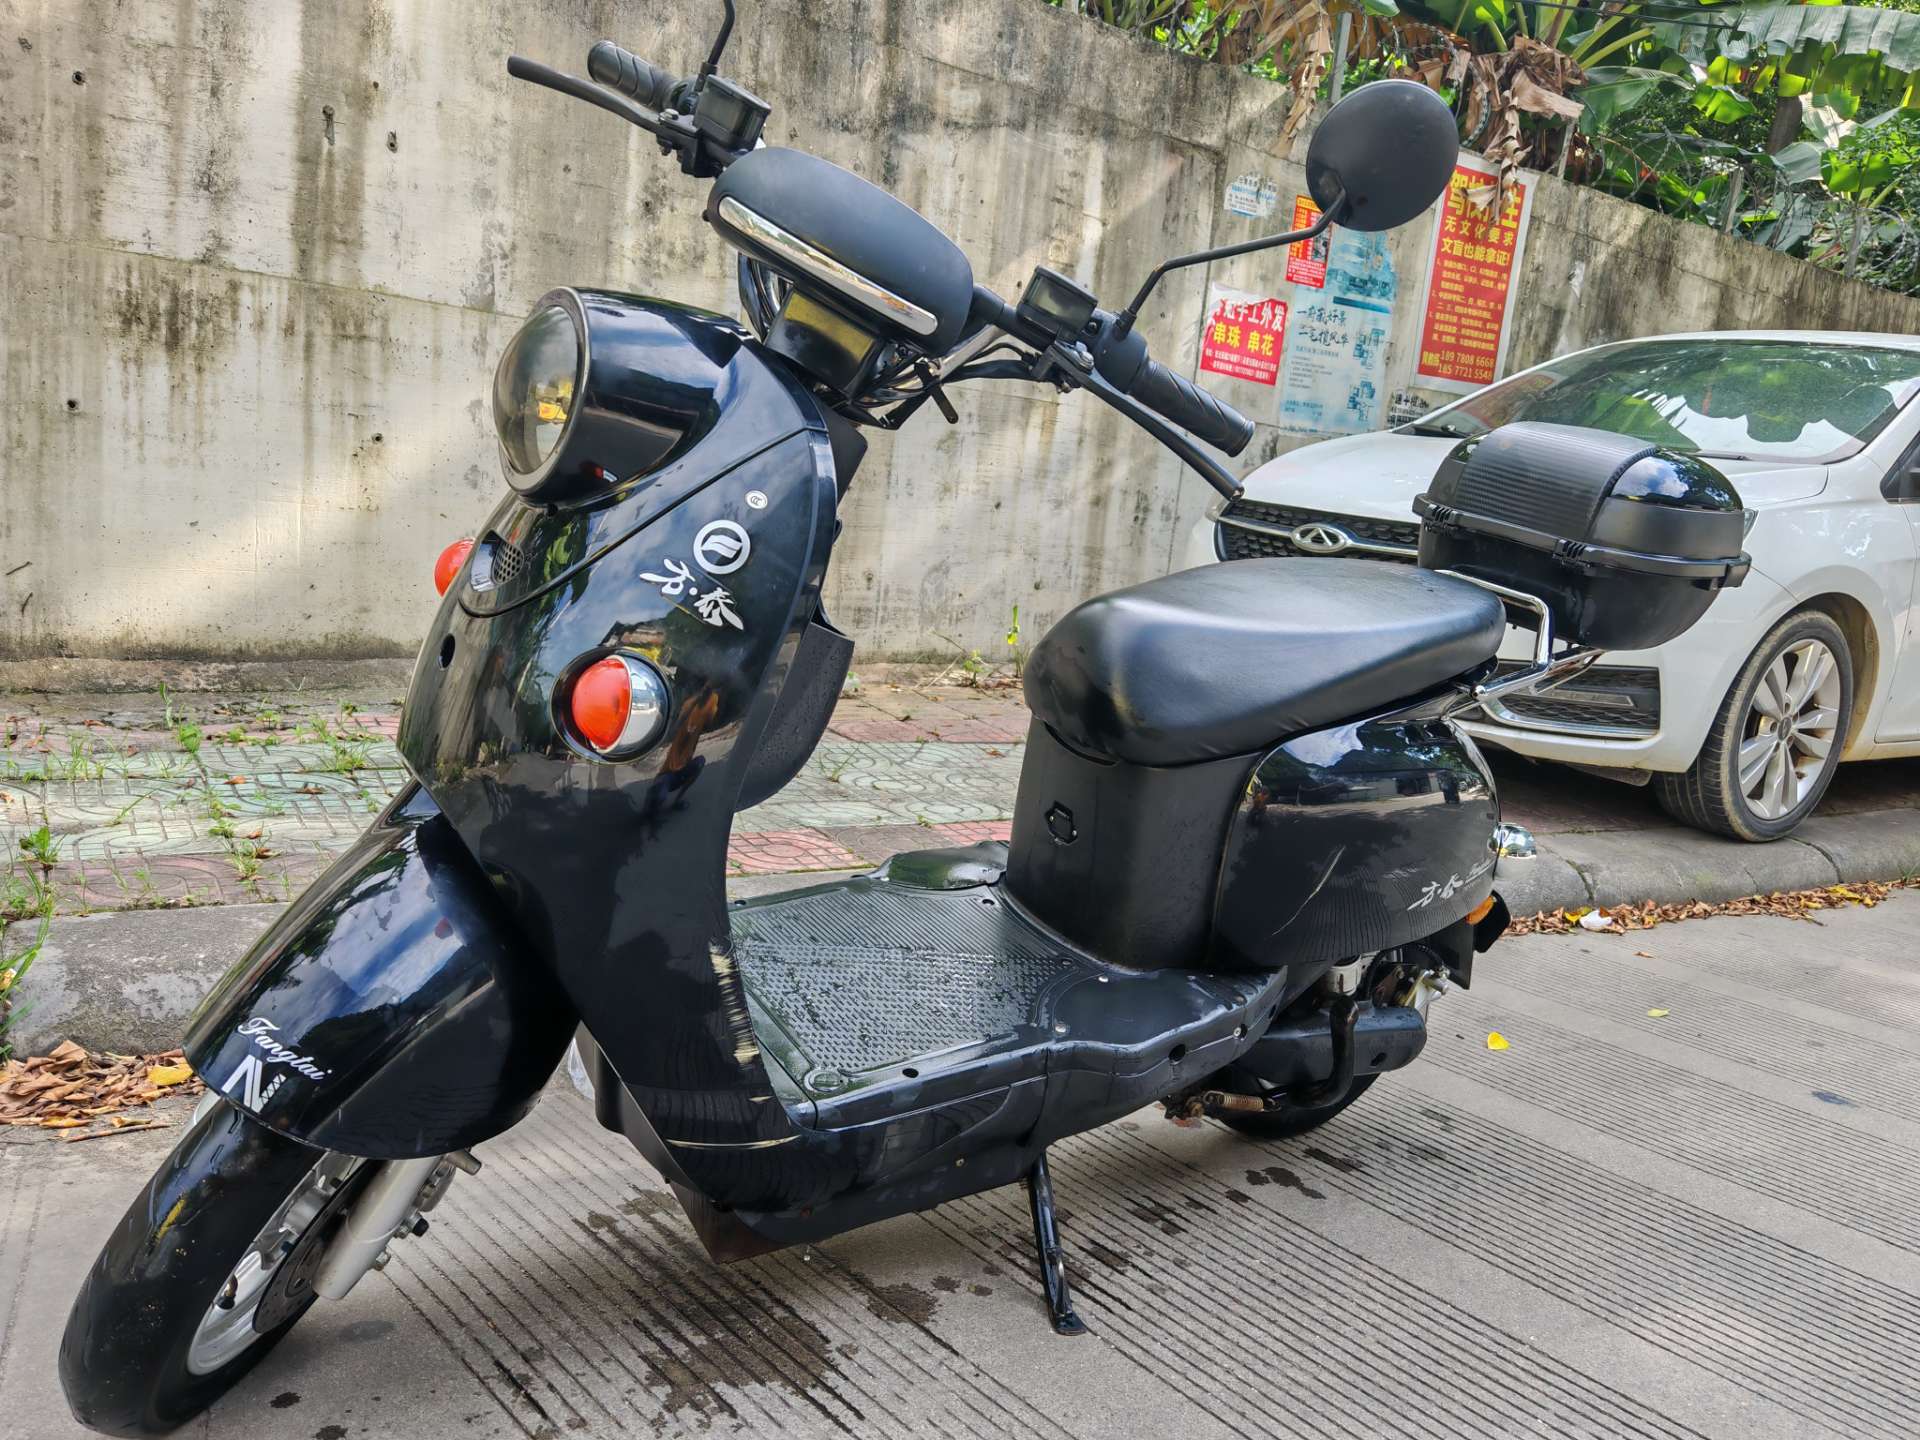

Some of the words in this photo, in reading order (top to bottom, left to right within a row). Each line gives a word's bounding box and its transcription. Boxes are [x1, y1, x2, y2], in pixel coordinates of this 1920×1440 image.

[1444, 216, 1515, 246] 无文化要求
[1213, 321, 1241, 348] 串珠
[1247, 329, 1275, 356] 串花
[237, 1017, 333, 1080] Fangtai
